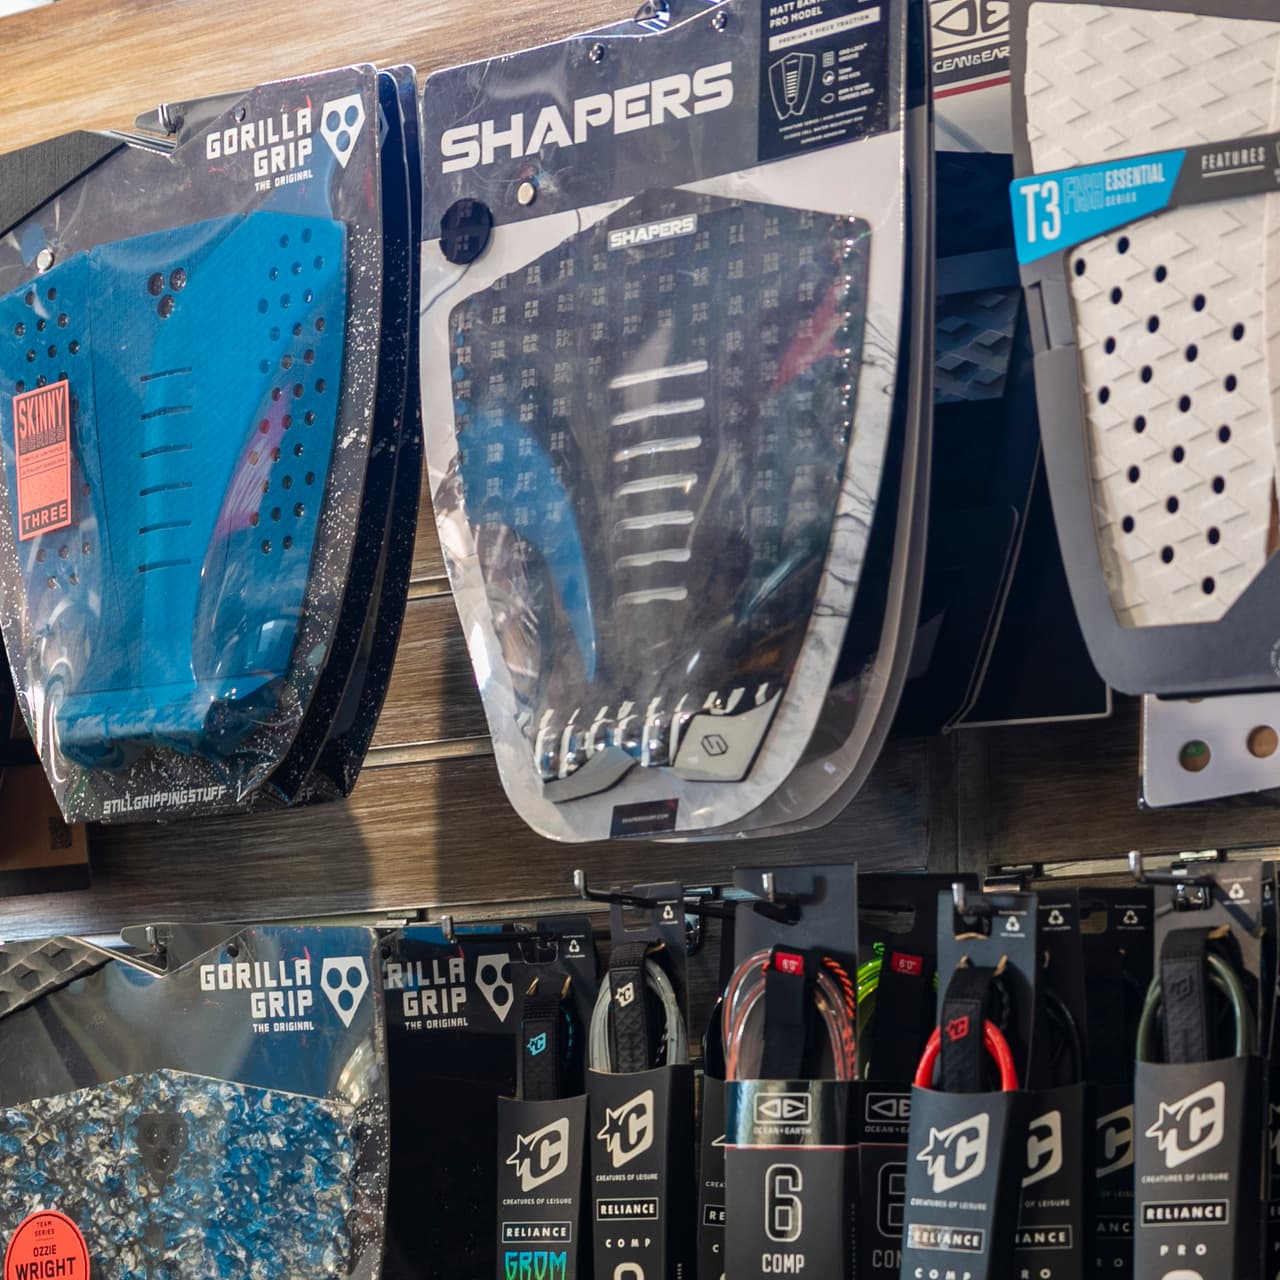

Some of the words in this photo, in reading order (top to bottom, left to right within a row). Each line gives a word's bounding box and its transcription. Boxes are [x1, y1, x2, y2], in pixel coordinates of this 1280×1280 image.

[769, 15, 790, 29] PRO
[791, 6, 824, 23] MODEL
[778, 31, 808, 44] PREMIUM
[836, 14, 871, 28] TRACTION
[440, 60, 735, 175] SHAPERS
[206, 107, 312, 160] GORILLA
[253, 138, 313, 178] GRIP
[1201, 147, 1266, 170] FEATURES
[255, 178, 271, 192] THE
[274, 169, 313, 188] ORIGINAL
[1019, 180, 1061, 243] T3
[1105, 162, 1166, 192] ESSENTIAL
[1105, 191, 1137, 207] SERIES
[608, 216, 696, 250] SHAPERS
[19, 387, 64, 440] SKINNY
[23, 504, 67, 531] THREE
[200, 959, 312, 992] GORILLA
[387, 958, 465, 988] RILLA
[250, 989, 314, 1020] GRIP
[403, 986, 468, 1019] GRIP
[252, 1022, 271, 1032] THE
[273, 1019, 315, 1032] ORIGINAL
[404, 1020, 423, 1031] THE
[425, 1016, 469, 1030] ORIGINAL
[596, 1173, 626, 1182] CREATURES
[636, 1173, 658, 1181] LEISURE
[1141, 1173, 1183, 1184] CREATURES
[1184, 1173, 1195, 1182] OF
[1197, 1172, 1229, 1182] LEISURE
[503, 1198, 535, 1206] CREATURES
[546, 1197, 572, 1205] LEISURE
[600, 1203, 654, 1215] RELIANCE
[765, 1163, 802, 1242] 6
[910, 1198, 948, 1209] CREATURES
[959, 1201, 987, 1211] LEISURE
[1024, 1200, 1036, 1208] OF
[1038, 1199, 1071, 1208] LEISURE
[1146, 1206, 1223, 1220] RELIANCE
[34, 1228, 55, 1237] SERIES
[506, 1226, 567, 1238] RELIANCE
[912, 1226, 980, 1247] RELIANCE
[33, 1244, 57, 1257] OZZIE
[605, 1238, 651, 1248] COMP
[1160, 1243, 1207, 1256] PRO
[761, 1253, 805, 1274] COMP
[915, 1267, 971, 1280] COMP
